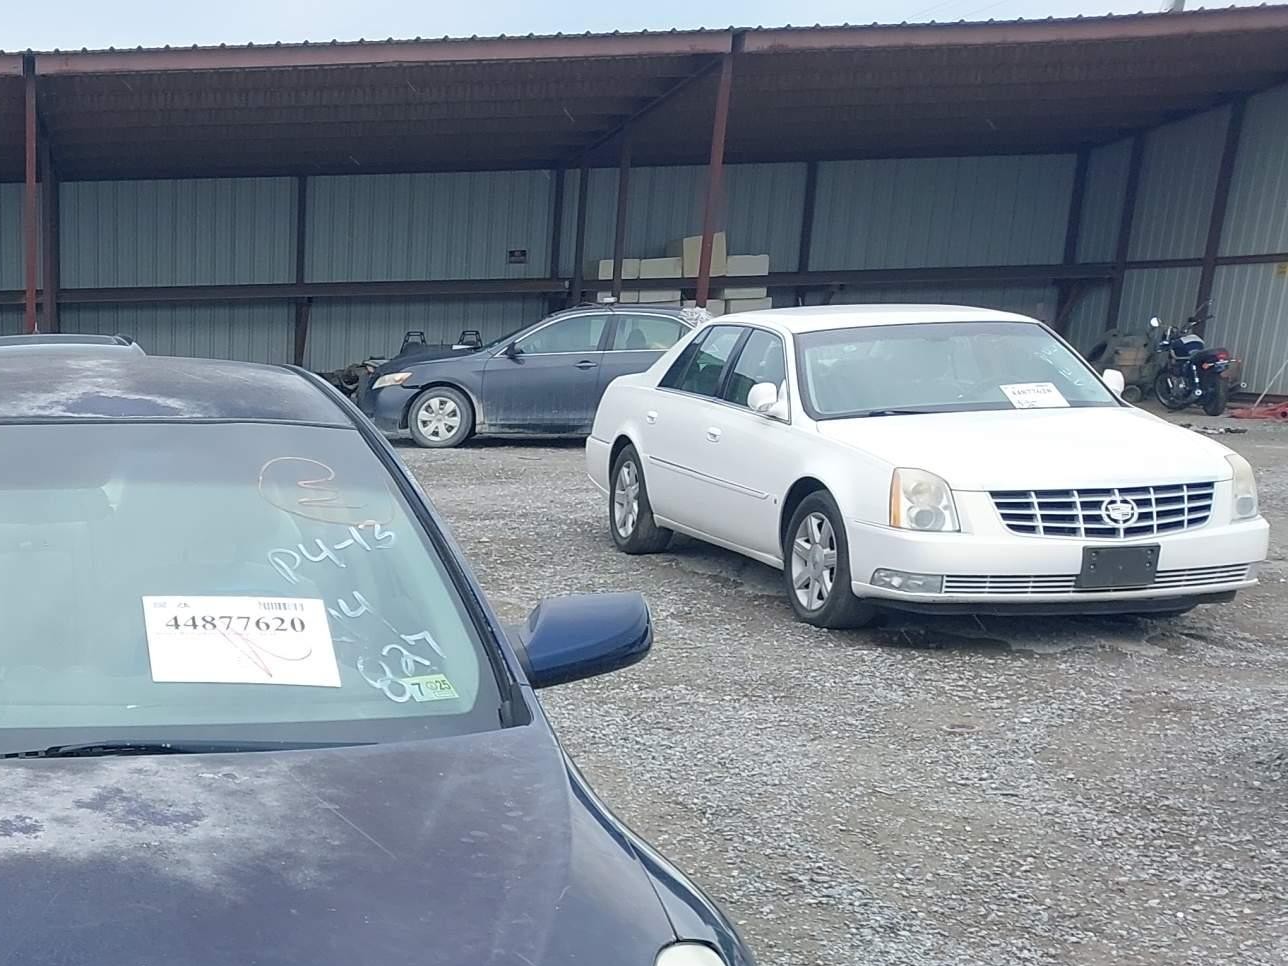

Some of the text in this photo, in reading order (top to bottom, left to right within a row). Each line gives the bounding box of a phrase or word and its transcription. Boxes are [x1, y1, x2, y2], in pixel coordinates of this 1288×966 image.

[165, 615, 306, 633] 44877620
[410, 679, 452, 697] 7 25
